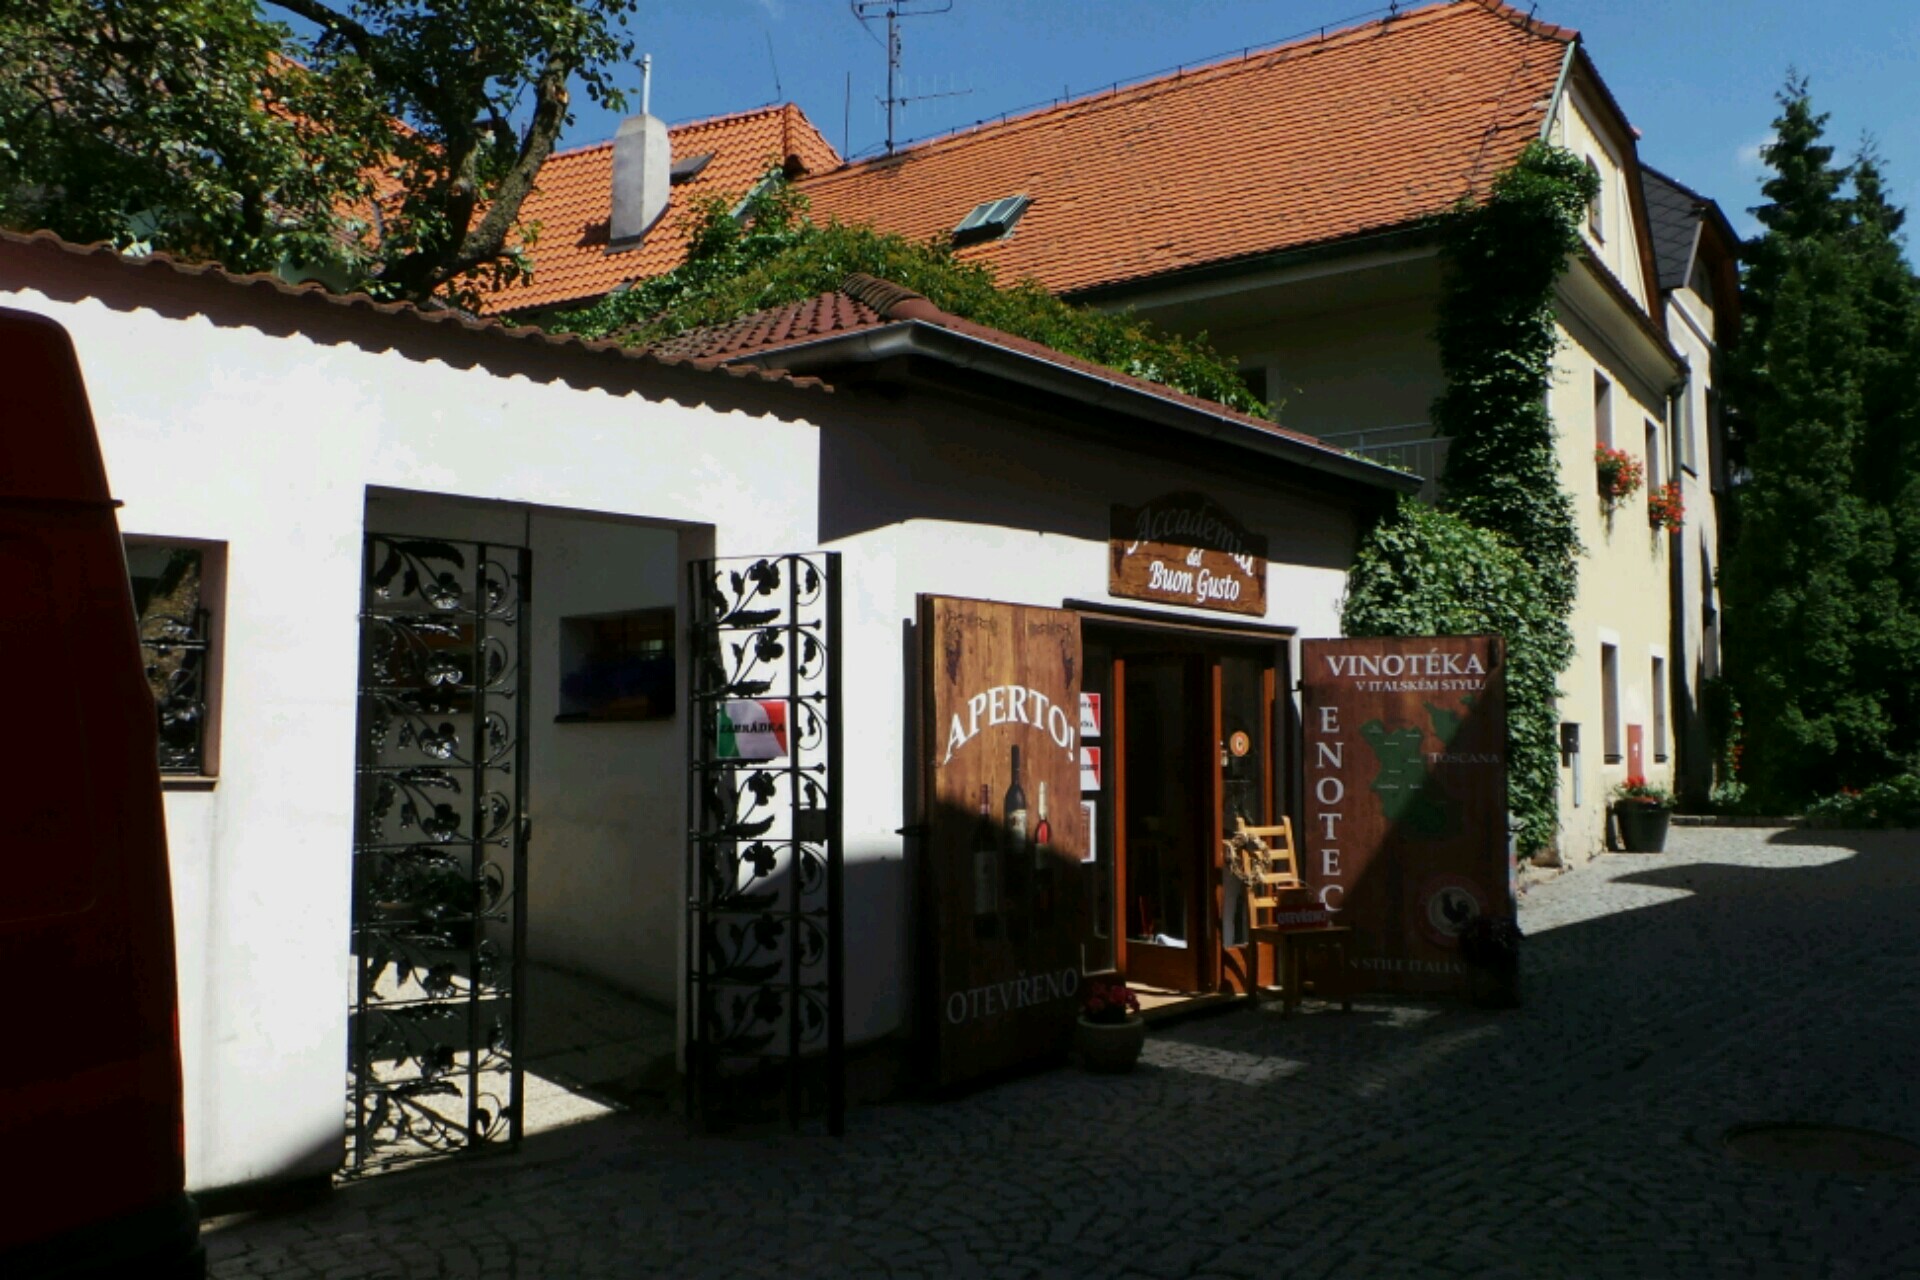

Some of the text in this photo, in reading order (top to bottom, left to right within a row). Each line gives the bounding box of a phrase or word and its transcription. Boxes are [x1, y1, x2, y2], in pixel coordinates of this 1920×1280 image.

[1148, 560, 1240, 602] Buon Gusto
[1325, 648, 1486, 677] VINOTÉKA
[1355, 680, 1366, 692] V
[1368, 678, 1439, 692] ITALSKÉM
[943, 684, 1076, 766] APERTO!
[1429, 752, 1500, 764] TOSCANA
[1315, 706, 1345, 926] ENOTEC
[946, 967, 1079, 1025] OTEVŘENO
